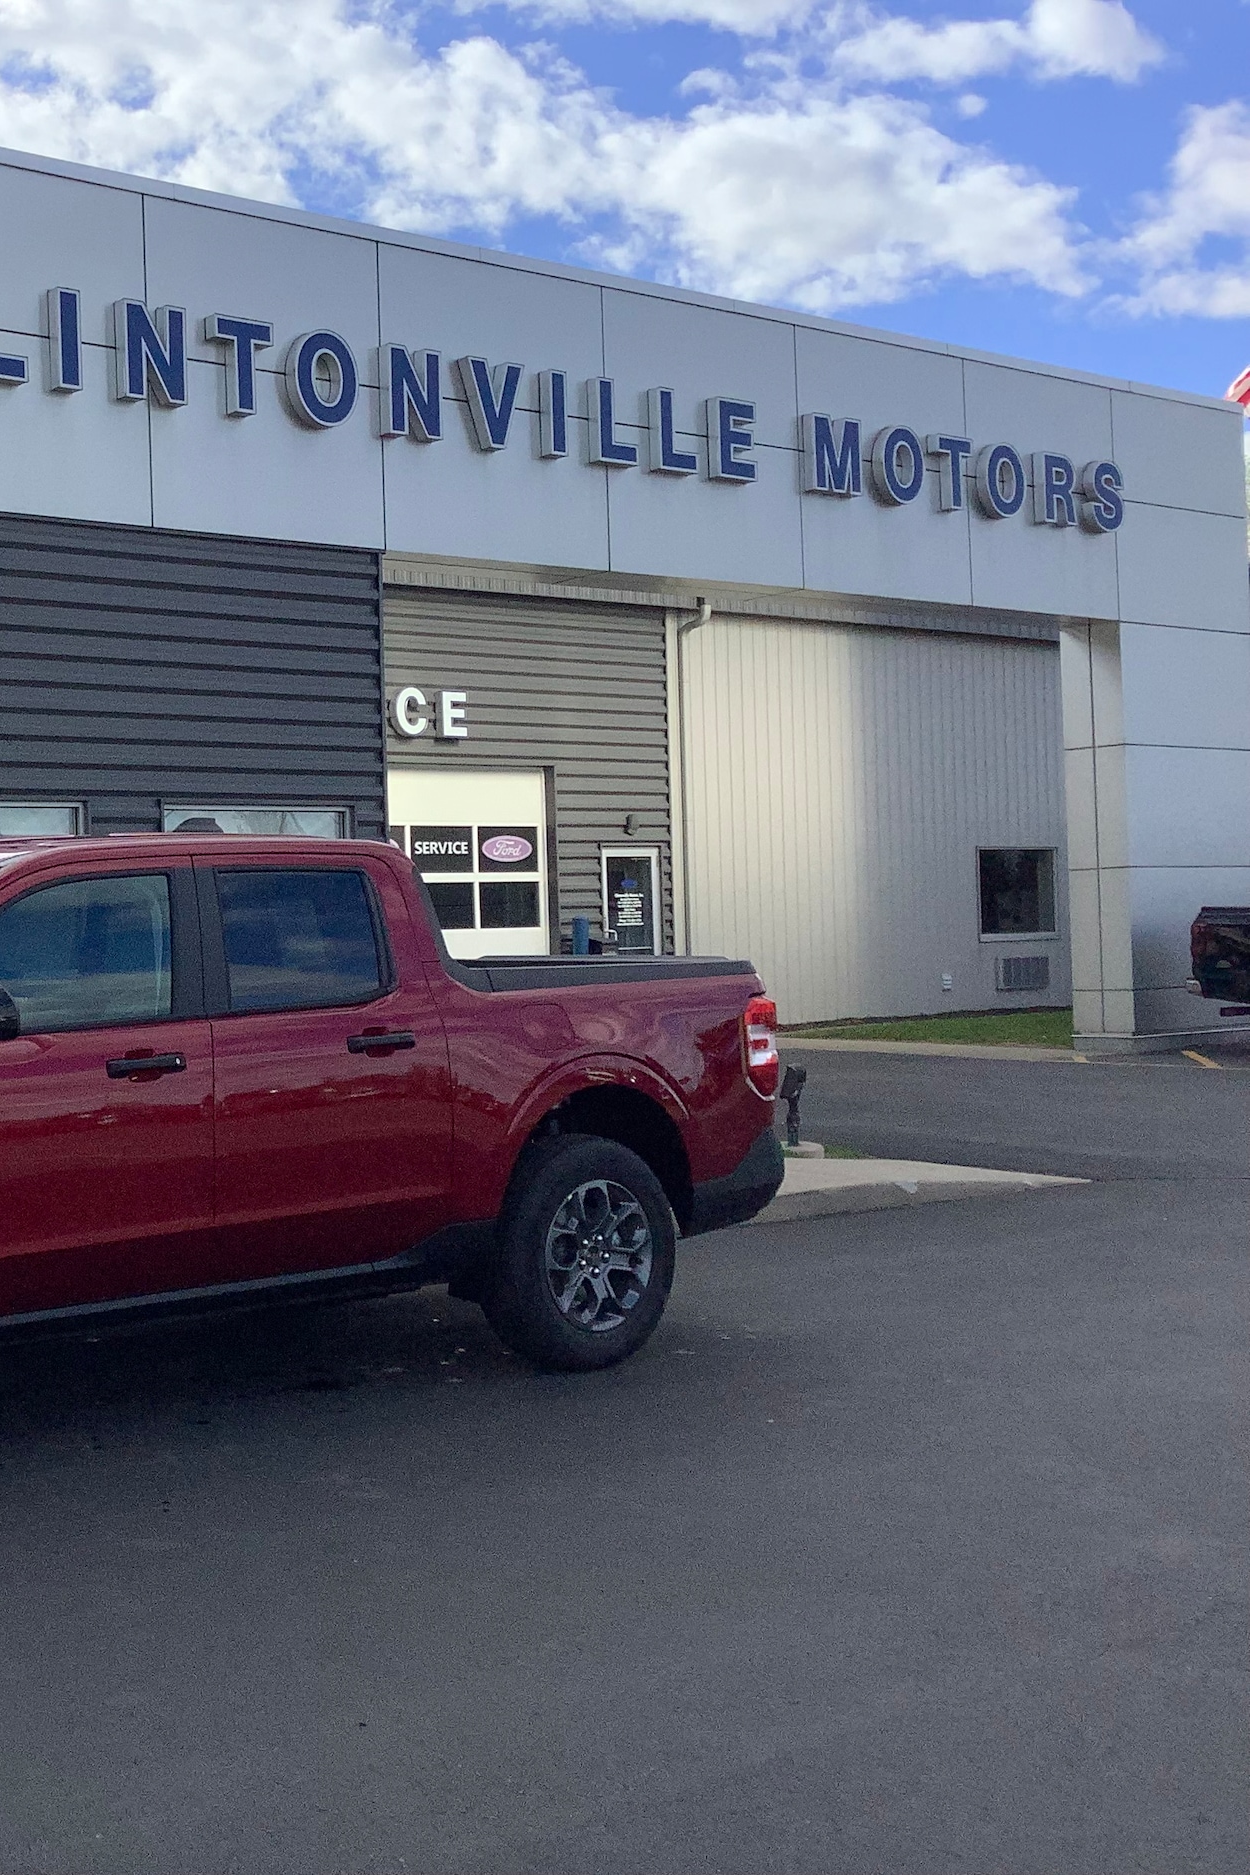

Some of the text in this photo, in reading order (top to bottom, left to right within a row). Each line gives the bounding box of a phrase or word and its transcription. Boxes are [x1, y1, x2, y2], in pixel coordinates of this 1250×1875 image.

[802, 412, 1125, 532] MOTORS
[414, 840, 469, 855] SERVICE
[492, 840, 522, 856] Ford
